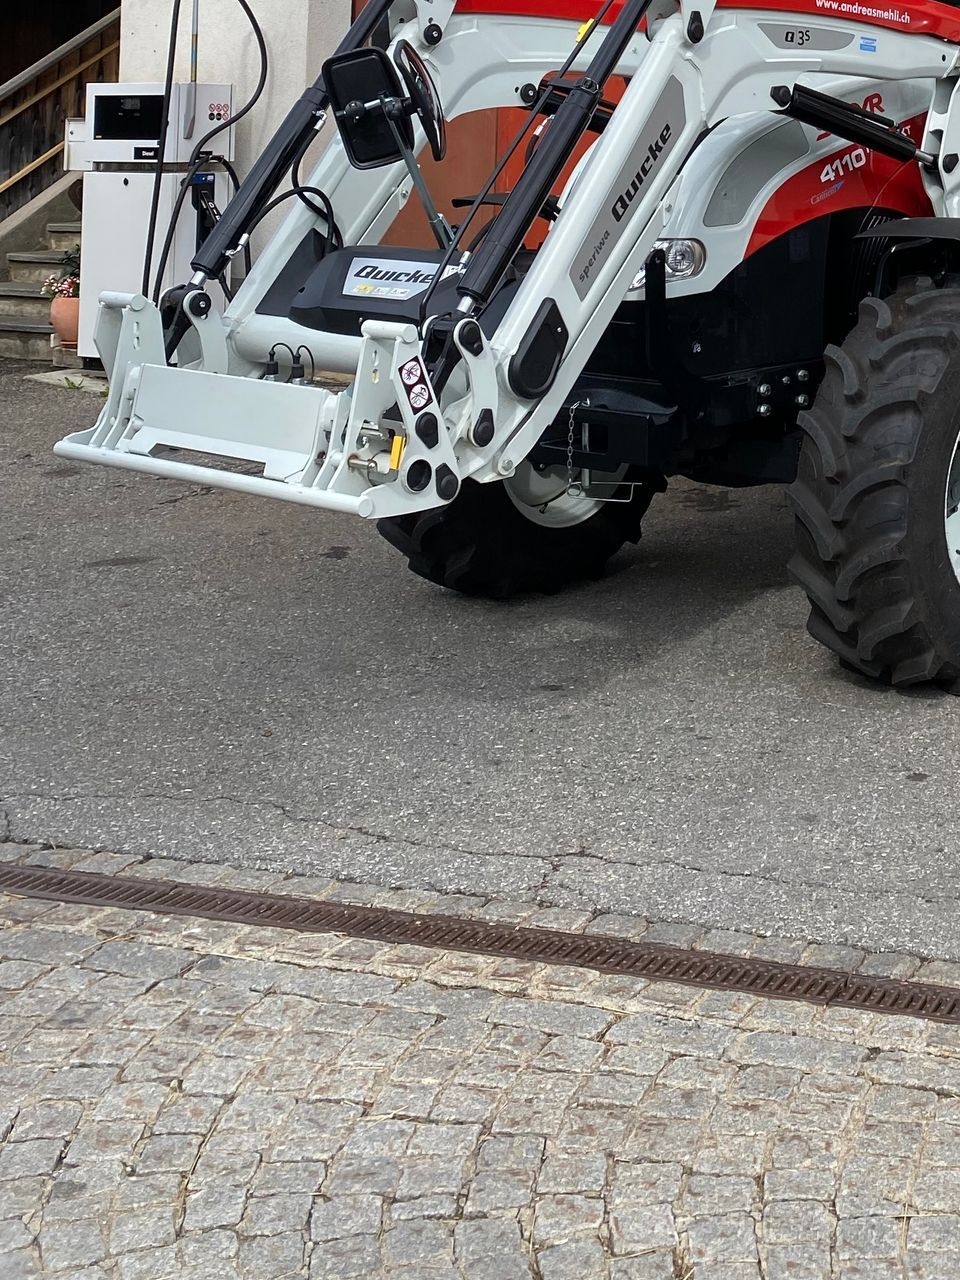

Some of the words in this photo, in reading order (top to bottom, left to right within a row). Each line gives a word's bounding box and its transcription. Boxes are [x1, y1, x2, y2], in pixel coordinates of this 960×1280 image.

[611, 122, 672, 223] Quicke
[820, 148, 866, 182] 4110
[353, 265, 437, 284] Quicke
[578, 230, 611, 283] speriwa
